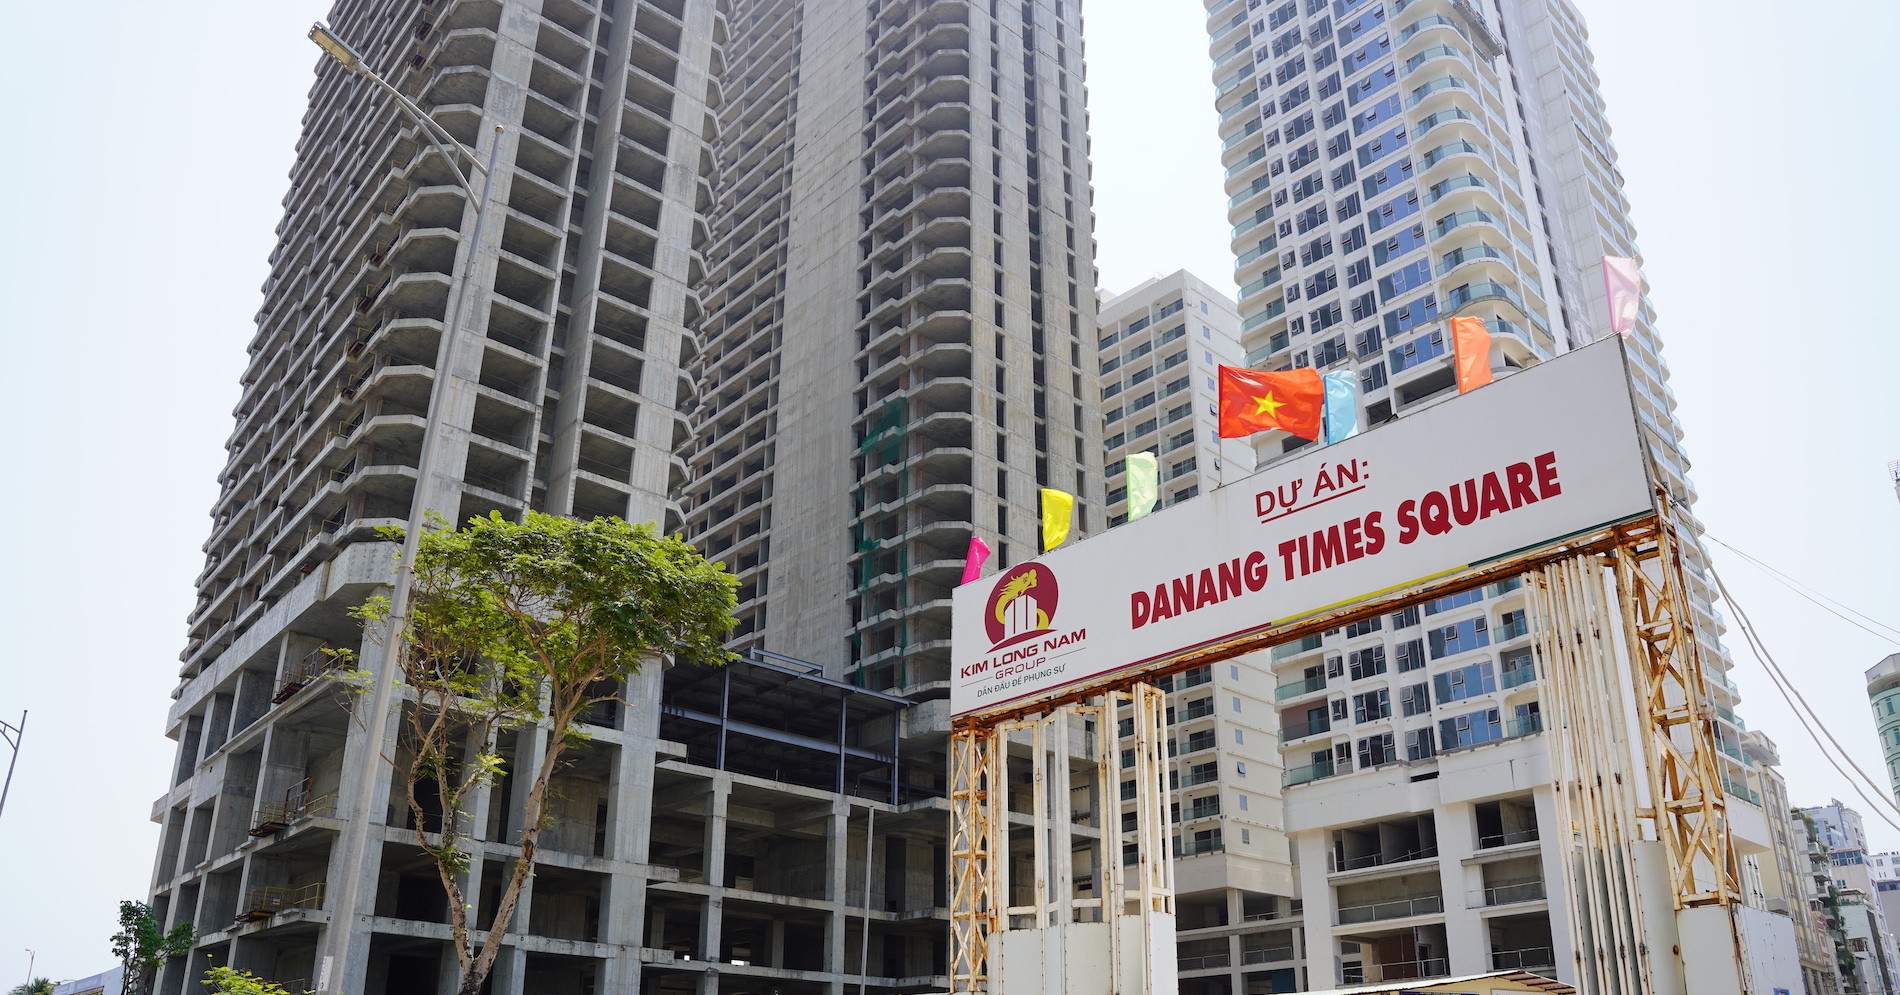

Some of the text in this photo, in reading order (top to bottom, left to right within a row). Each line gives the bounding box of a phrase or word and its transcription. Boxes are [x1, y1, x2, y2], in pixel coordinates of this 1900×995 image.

[1255, 457, 1370, 518] DỰ ÁN:
[1130, 450, 1562, 630] DANANG TIMES SQUARE
[960, 628, 1087, 679] KIM LONG NAM
[995, 656, 1046, 680] GROUP
